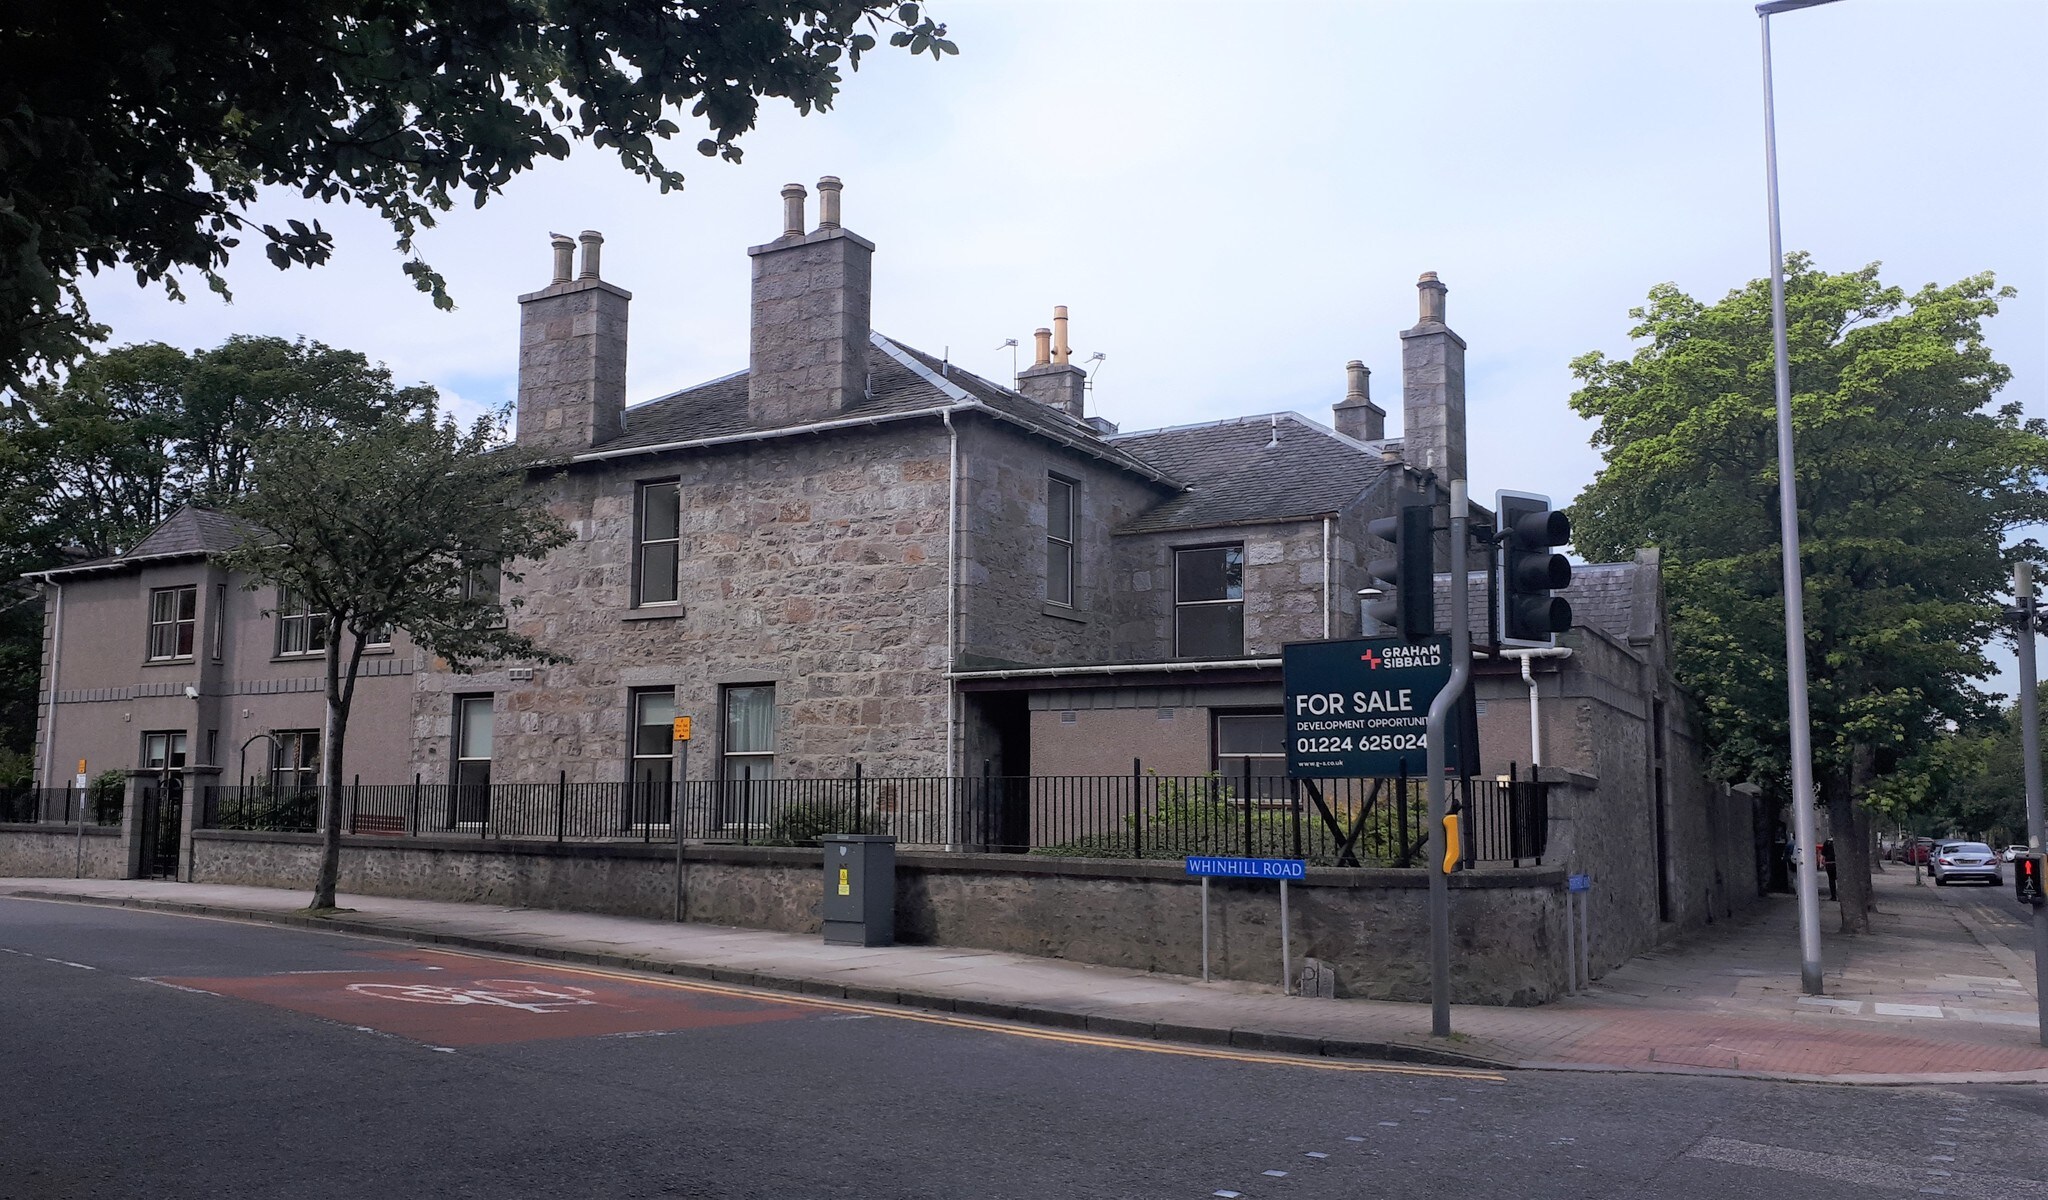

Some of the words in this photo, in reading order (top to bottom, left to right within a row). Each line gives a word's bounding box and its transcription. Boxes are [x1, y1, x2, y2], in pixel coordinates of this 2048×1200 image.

[1382, 644, 1441, 658] GRAHAM
[1383, 655, 1441, 669] SIBBALD
[1296, 693, 1345, 716] FOR
[1353, 689, 1413, 713] SALE
[1297, 719, 1365, 731] DEVELOPMENT
[1367, 716, 1429, 729] OPPORTUNIT
[1297, 736, 1353, 753] 01224
[1358, 733, 1428, 751] 625024
[1189, 859, 1259, 875] WHINHILL
[1263, 862, 1302, 876] ROAD
